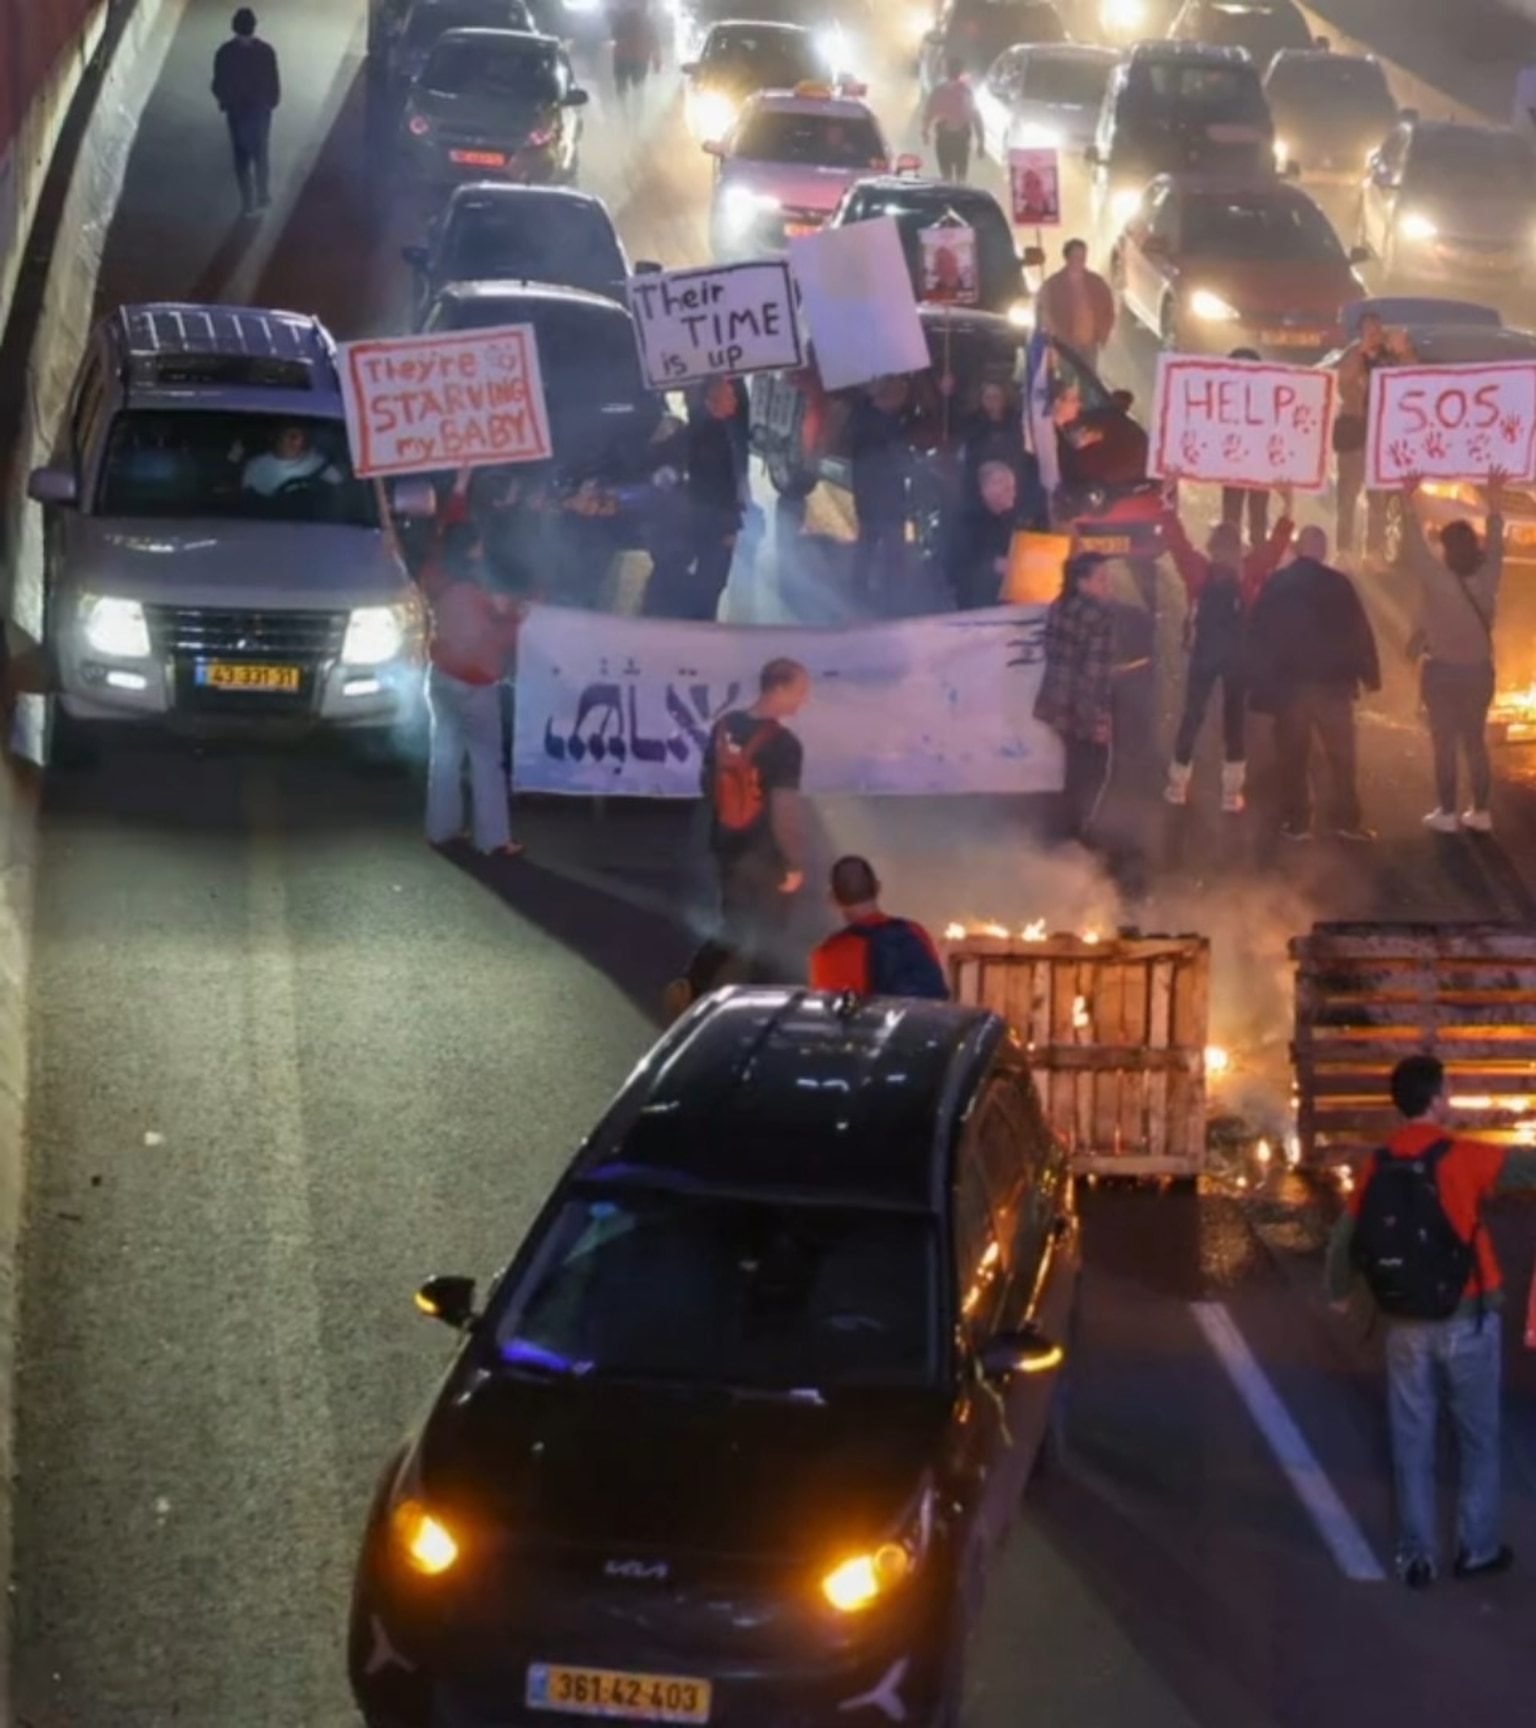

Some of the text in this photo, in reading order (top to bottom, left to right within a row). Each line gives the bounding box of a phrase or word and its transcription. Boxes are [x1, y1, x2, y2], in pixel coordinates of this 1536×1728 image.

[633, 280, 725, 320] Their
[680, 302, 780, 348] TIME
[366, 351, 476, 383] They're
[660, 344, 743, 375] is up
[370, 377, 525, 434] STARVING
[1183, 379, 1296, 426] HELP
[395, 409, 526, 460] my BABY
